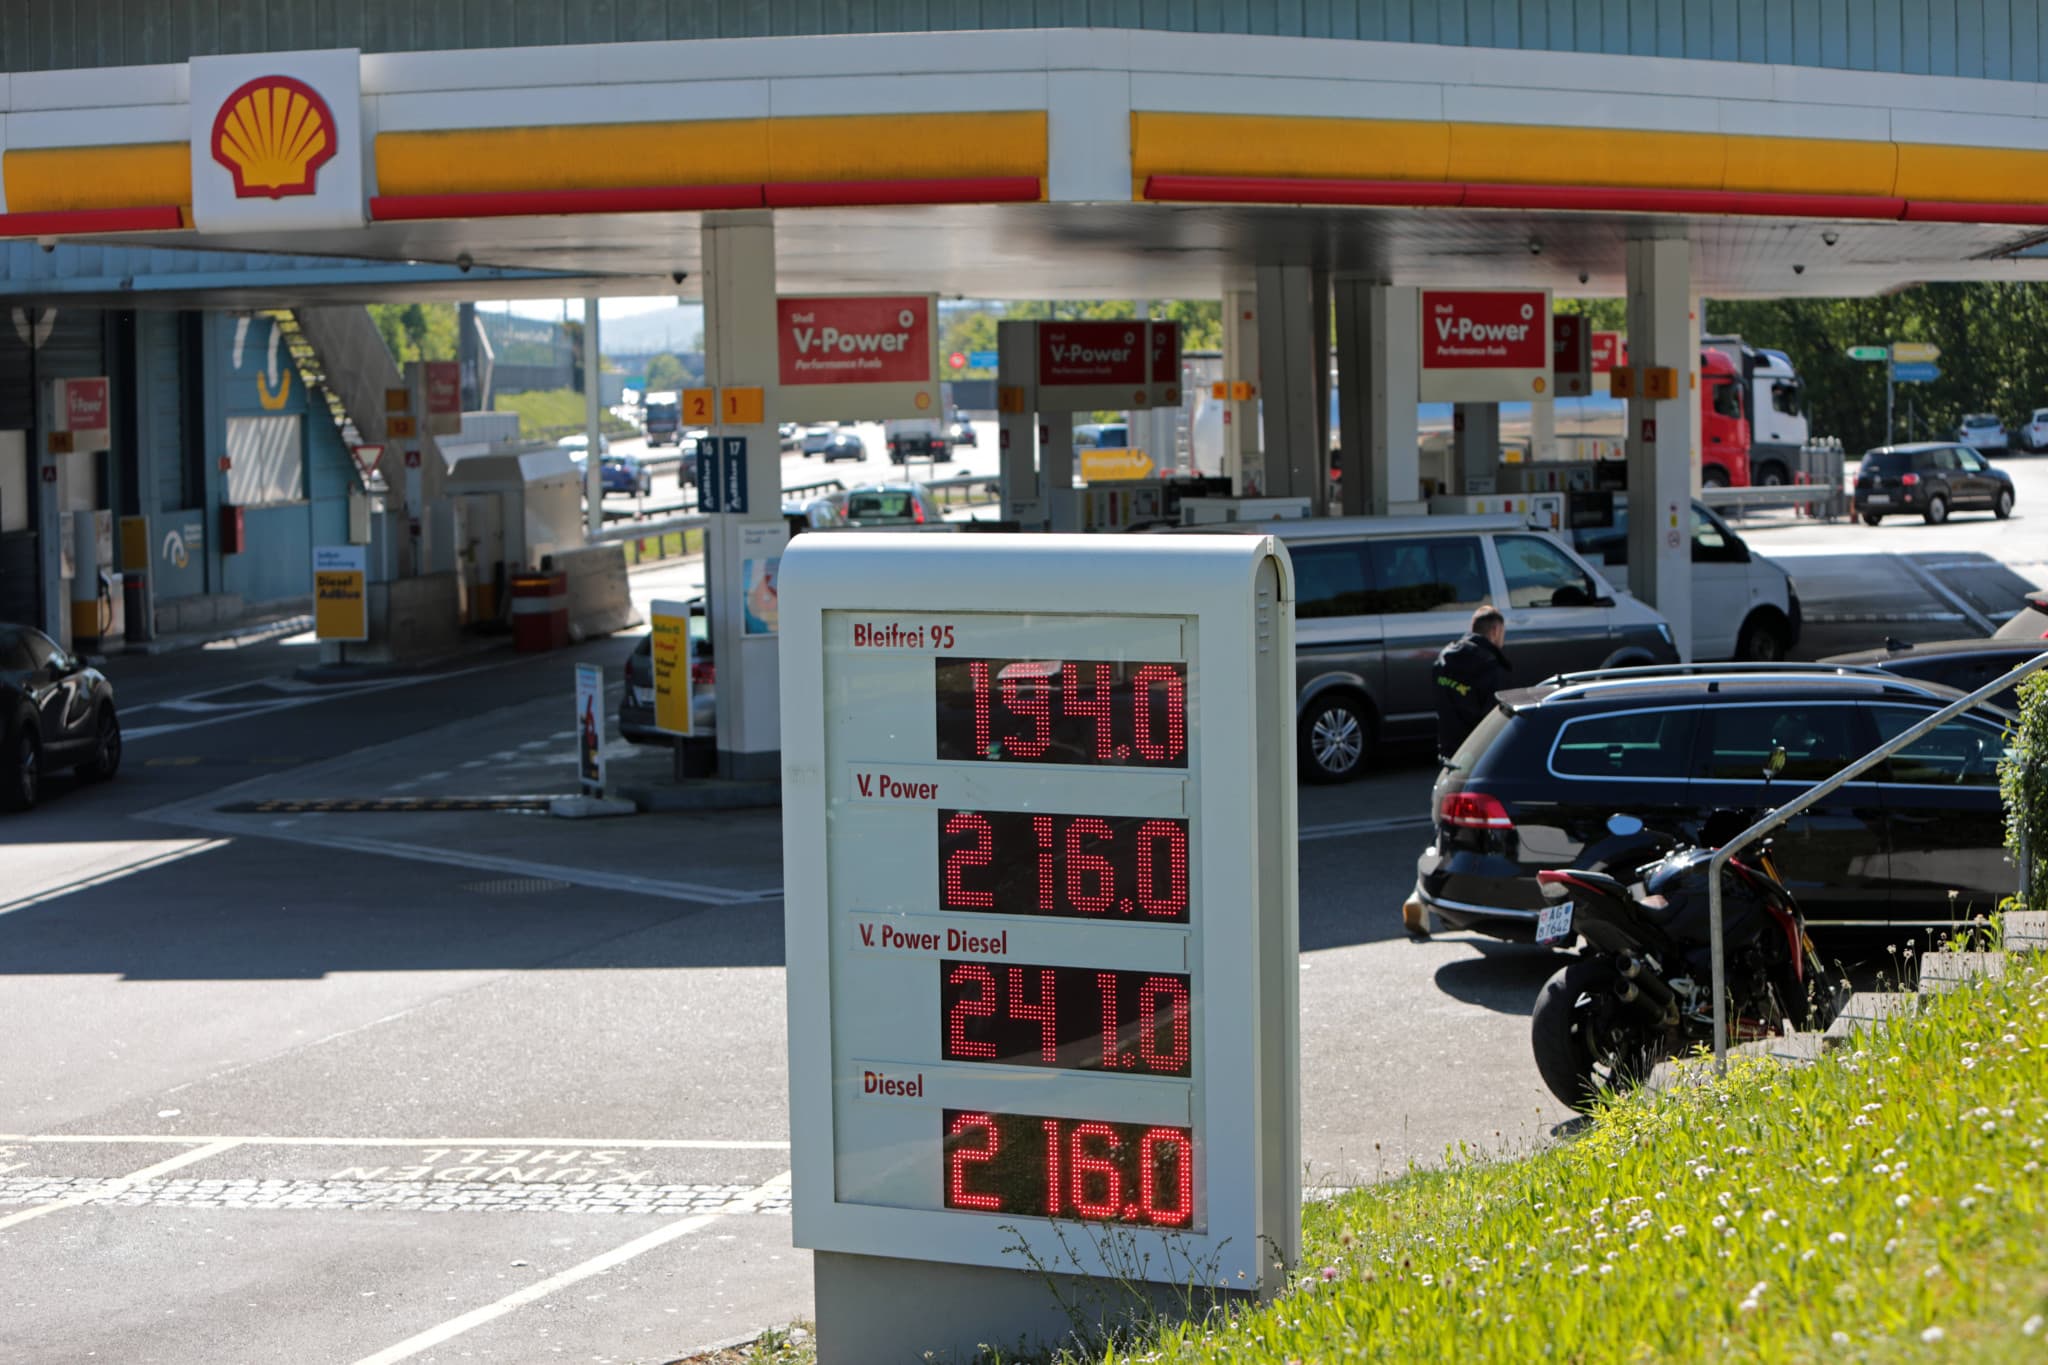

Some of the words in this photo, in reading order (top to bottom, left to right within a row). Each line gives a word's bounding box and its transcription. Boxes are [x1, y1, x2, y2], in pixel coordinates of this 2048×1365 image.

[792, 327, 909, 353] V-Power
[1435, 317, 1529, 341] V-Power
[1051, 345, 1131, 362] V-Power
[694, 397, 705, 416] 2
[730, 397, 738, 415] 1
[729, 441, 741, 456] 17
[319, 575, 353, 586] Diesel
[854, 622, 924, 648] Bleifrei
[930, 625, 955, 649] 95
[969, 661, 1184, 761] 194.0
[857, 773, 873, 797] V.
[879, 774, 939, 800] Power
[946, 813, 1187, 916] 216.0
[1550, 906, 1563, 920] AG
[859, 923, 875, 947] V.
[882, 924, 941, 951] Power
[947, 928, 1007, 955] Diesel
[949, 964, 1189, 1072] 241.0
[864, 1070, 923, 1097] Diesel
[422, 1149, 627, 1165] SHELL
[951, 1114, 1191, 1225] 216.0
[331, 1165, 653, 1182] KUNDEN
